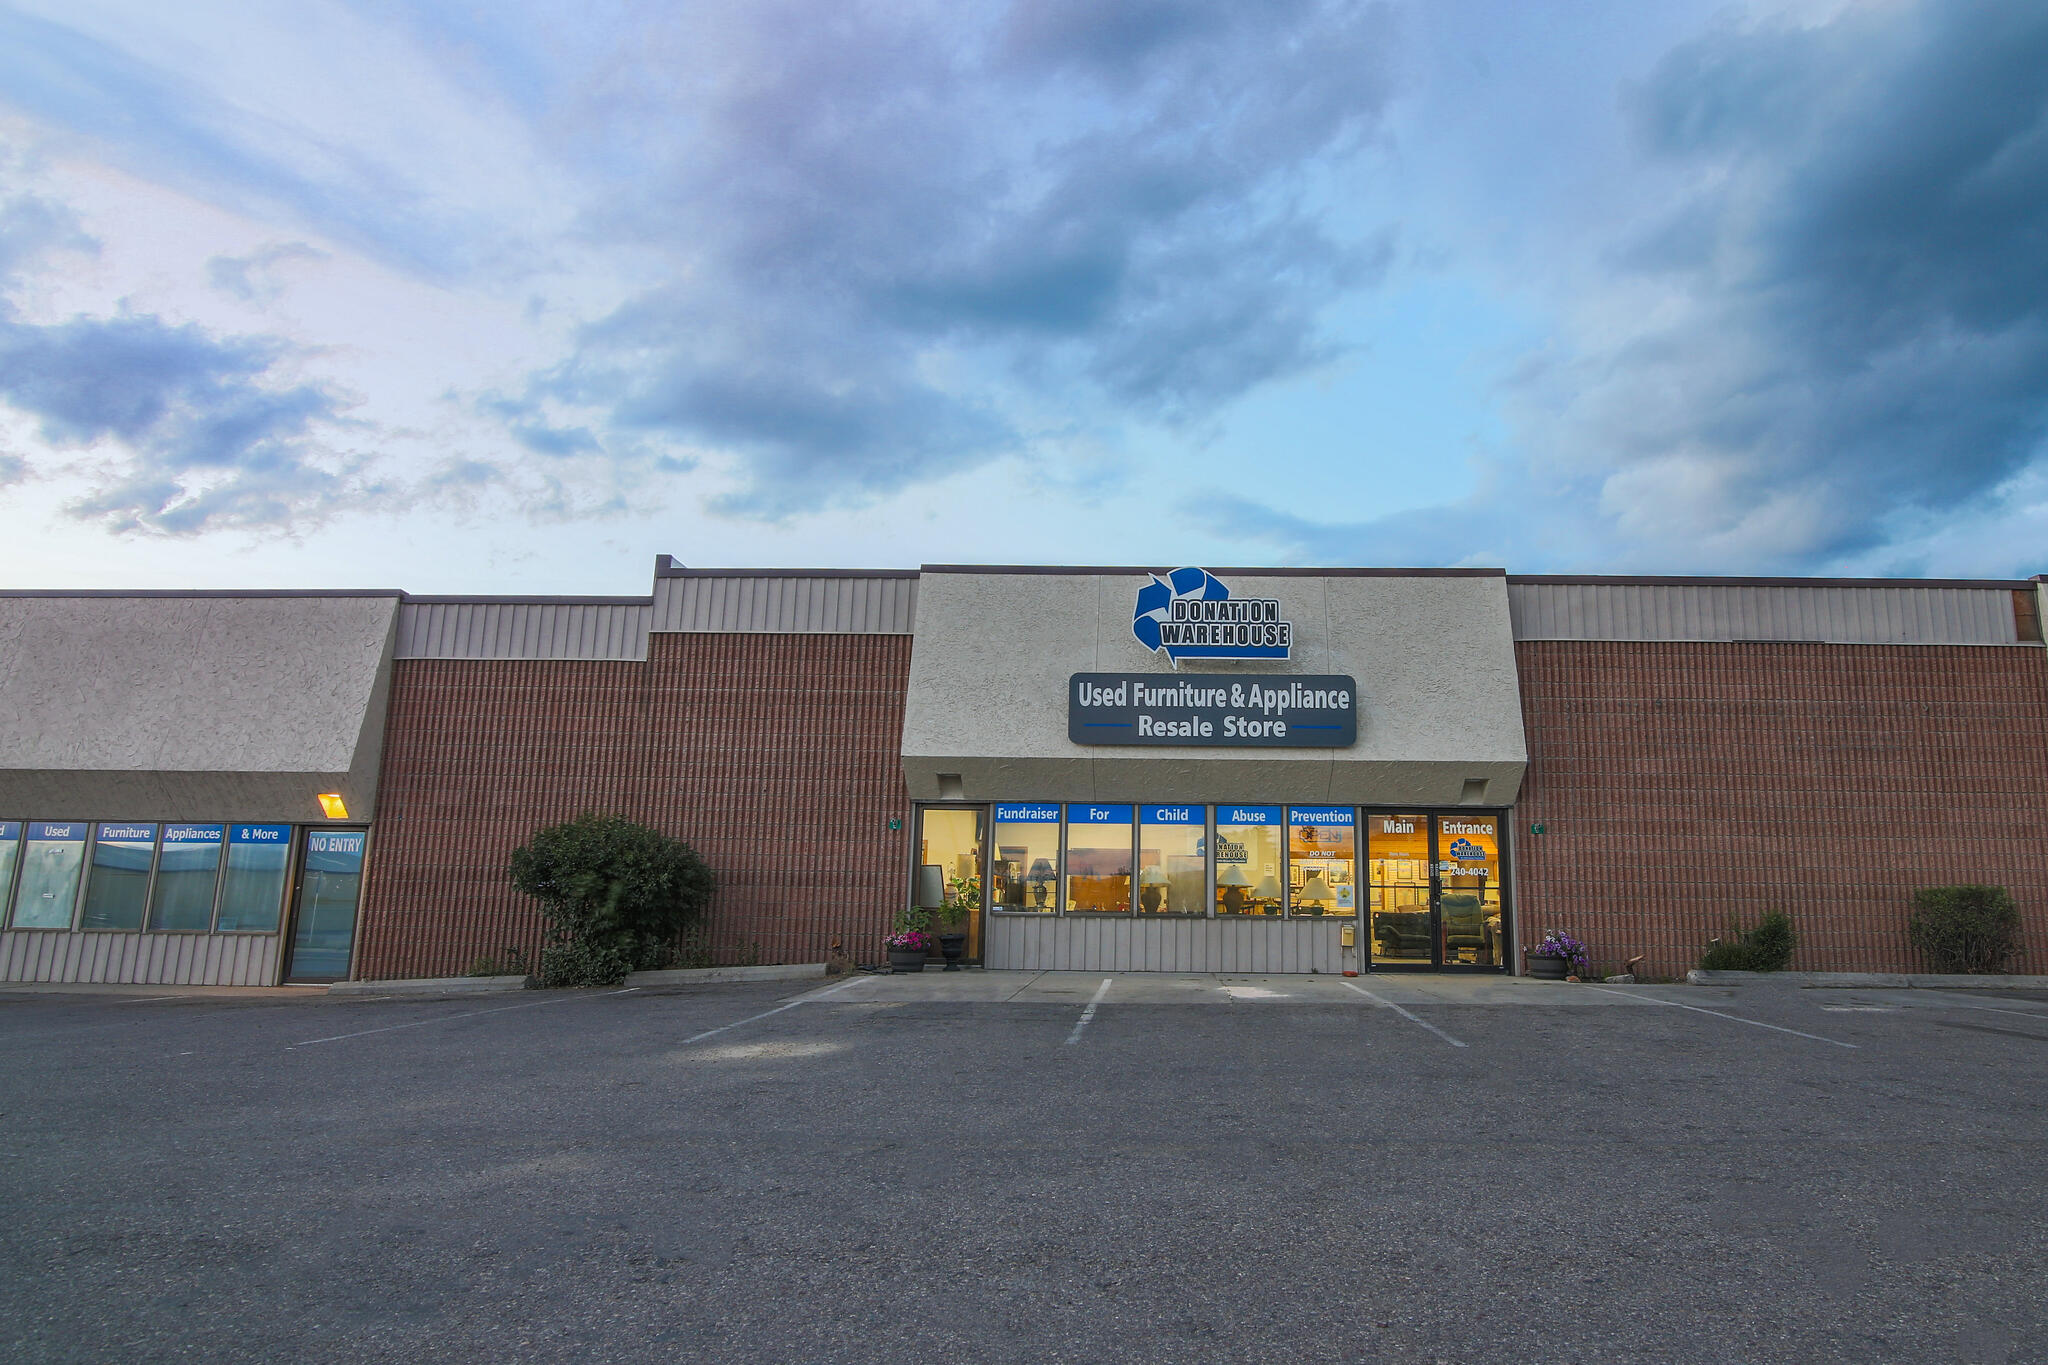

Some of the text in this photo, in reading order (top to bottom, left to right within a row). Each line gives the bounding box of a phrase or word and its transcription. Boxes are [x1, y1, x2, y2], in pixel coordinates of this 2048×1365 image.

[1175, 600, 1277, 622] DONATION
[1161, 624, 1290, 647] WAREHOUSE
[1078, 681, 1350, 716] Used Furniture & Appliance
[1138, 715, 1287, 738] Resale Store
[997, 807, 1058, 820] Fundraiser
[1090, 808, 1110, 821] For
[1156, 809, 1189, 821] Child
[1232, 810, 1266, 822] Abuse
[1291, 810, 1352, 823] Prevention
[44, 825, 70, 837] Used
[103, 826, 150, 839] Furniture
[1383, 819, 1414, 834] Main
[1442, 820, 1493, 835] Entrance
[165, 827, 221, 841] Appliances
[241, 828, 279, 840] & More
[311, 838, 362, 853] NO ENTRY
[1451, 868, 1489, 876] 240-4042
